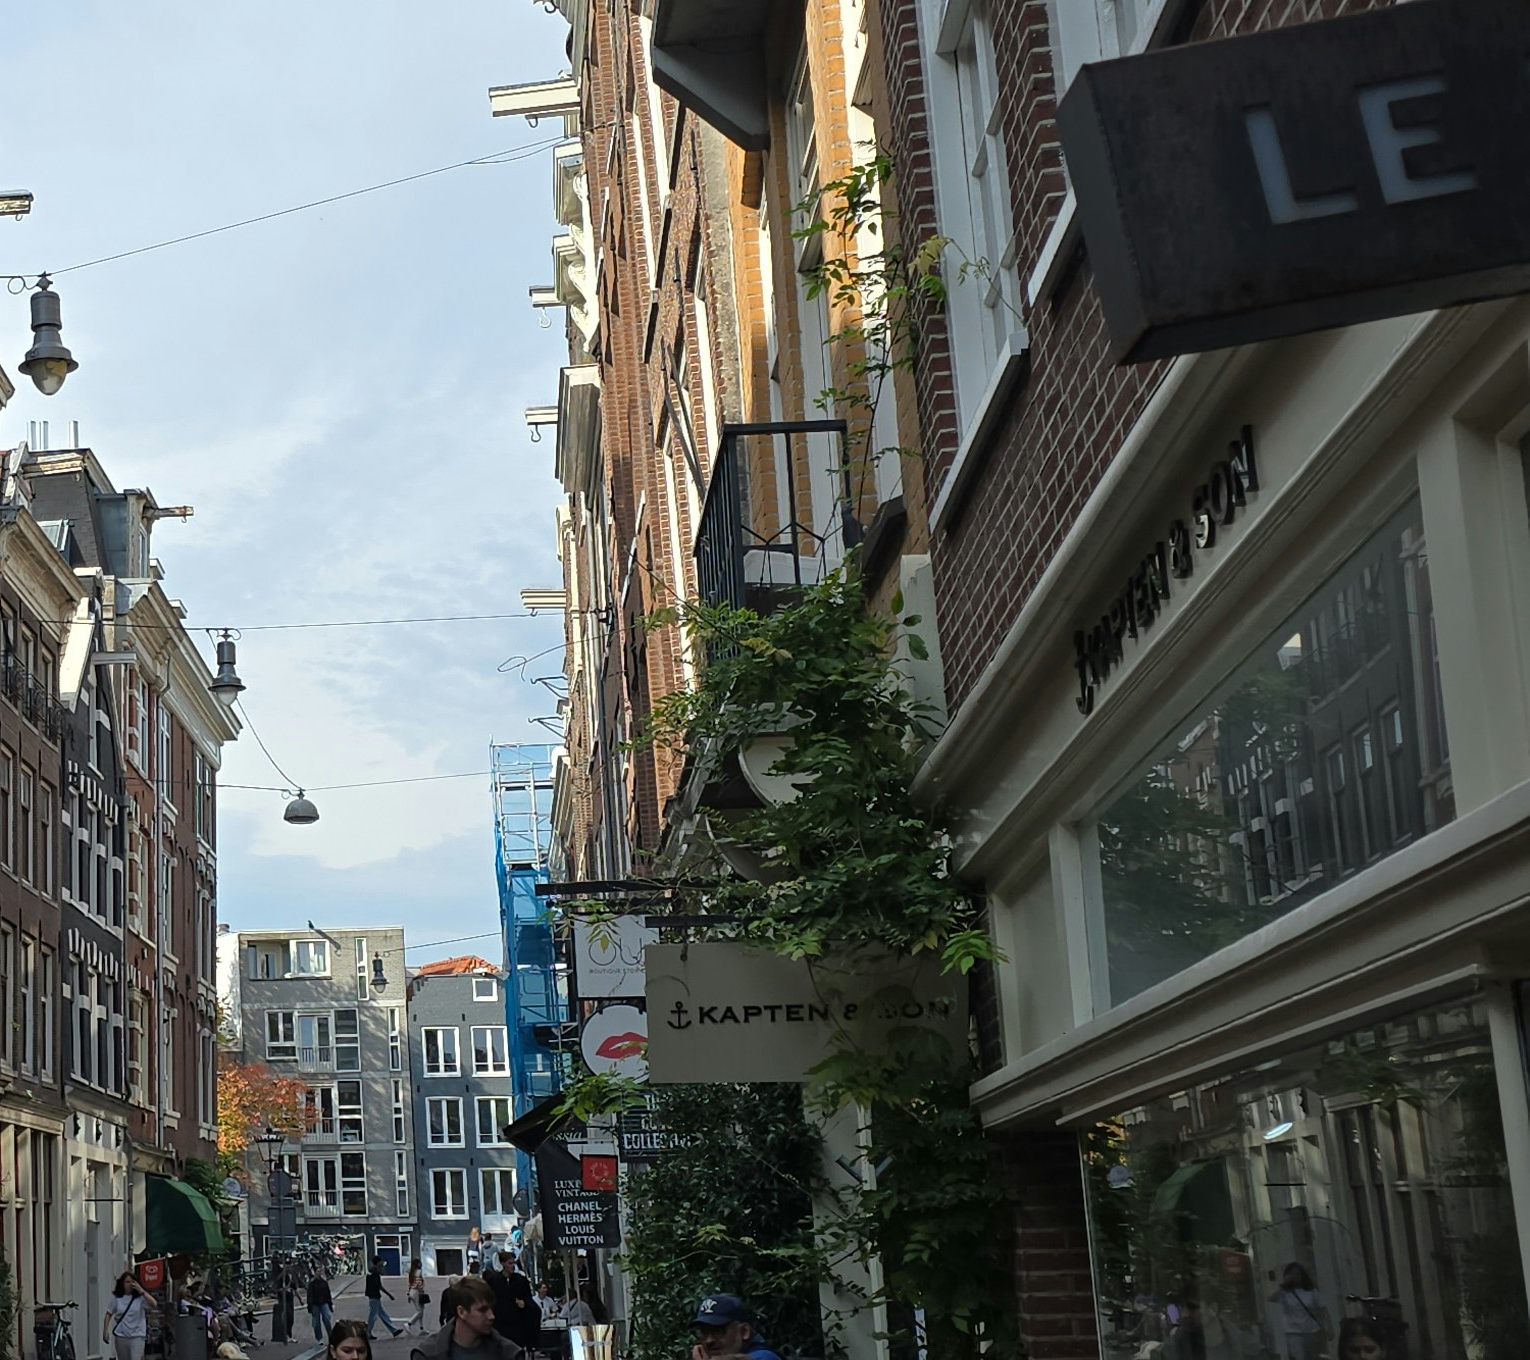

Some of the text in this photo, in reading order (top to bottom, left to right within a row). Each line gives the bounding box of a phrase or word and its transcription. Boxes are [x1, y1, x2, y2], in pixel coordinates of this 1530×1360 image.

[1193, 424, 1259, 549] SON
[698, 1002, 829, 1025] KAPTEN
[557, 1200, 602, 1213] CHANEL
[565, 1224, 596, 1235] LOUIS
[557, 1234, 605, 1246] VUITTON
